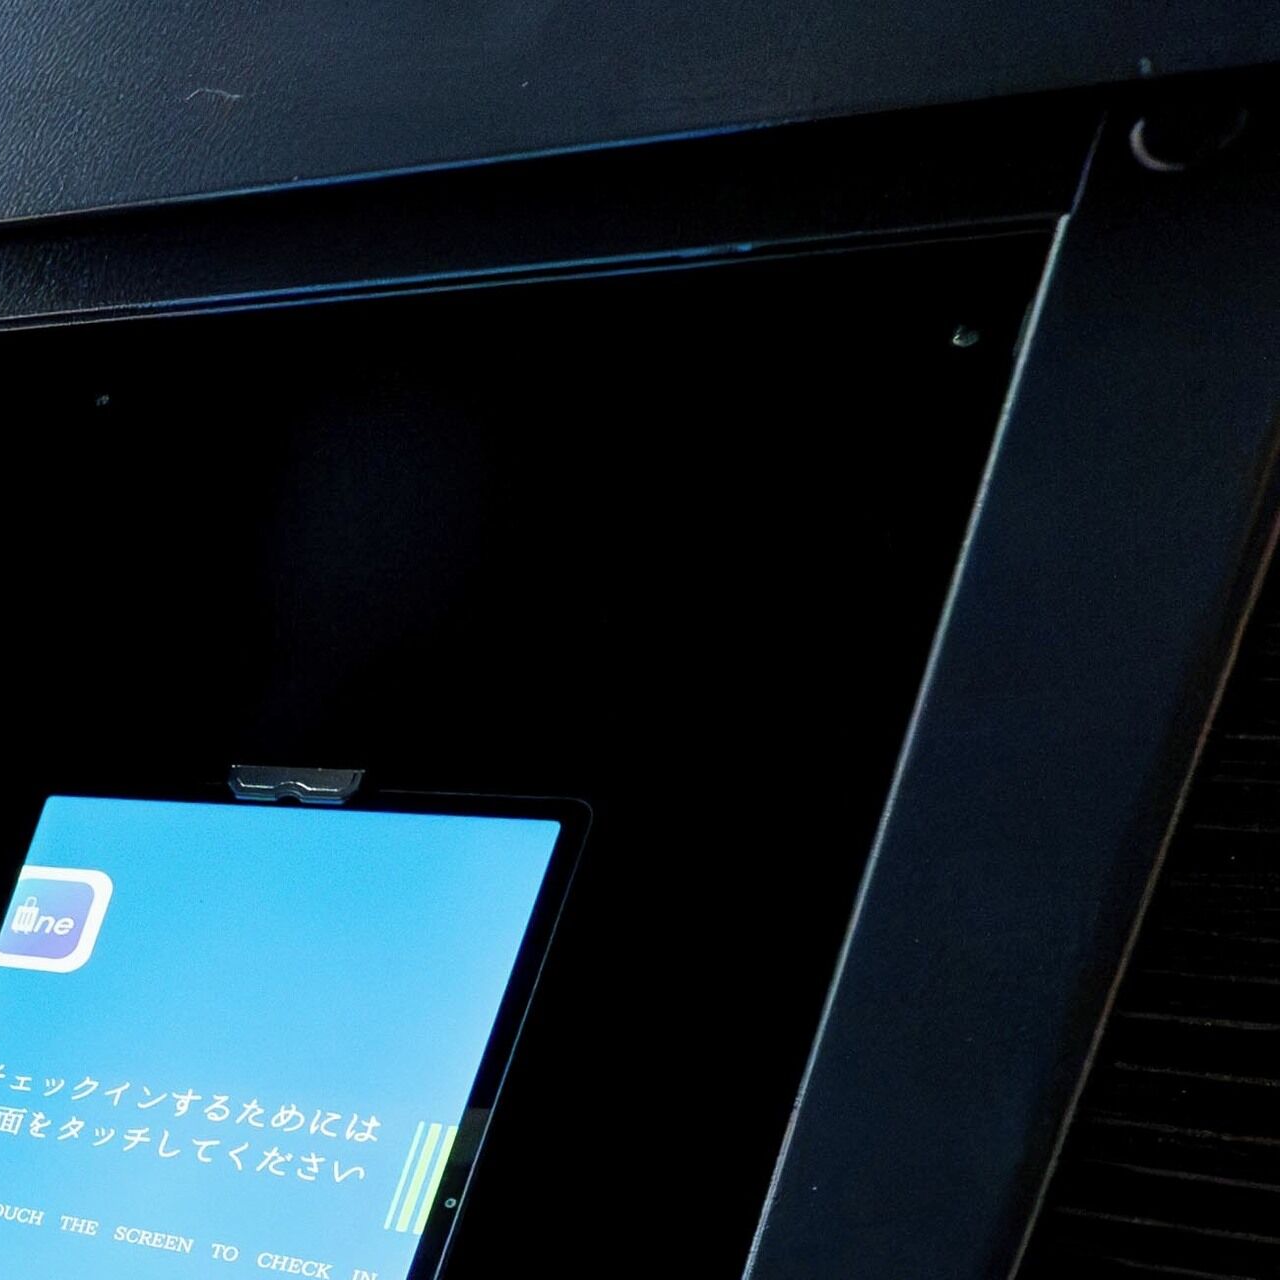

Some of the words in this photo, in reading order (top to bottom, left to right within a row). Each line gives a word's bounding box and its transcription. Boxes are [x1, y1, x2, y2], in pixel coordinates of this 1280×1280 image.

[60, 1215, 99, 1236] THE
[113, 1225, 194, 1254] SCREEN
[211, 1243, 239, 1262] TO
[257, 1252, 333, 1280] CHECK
